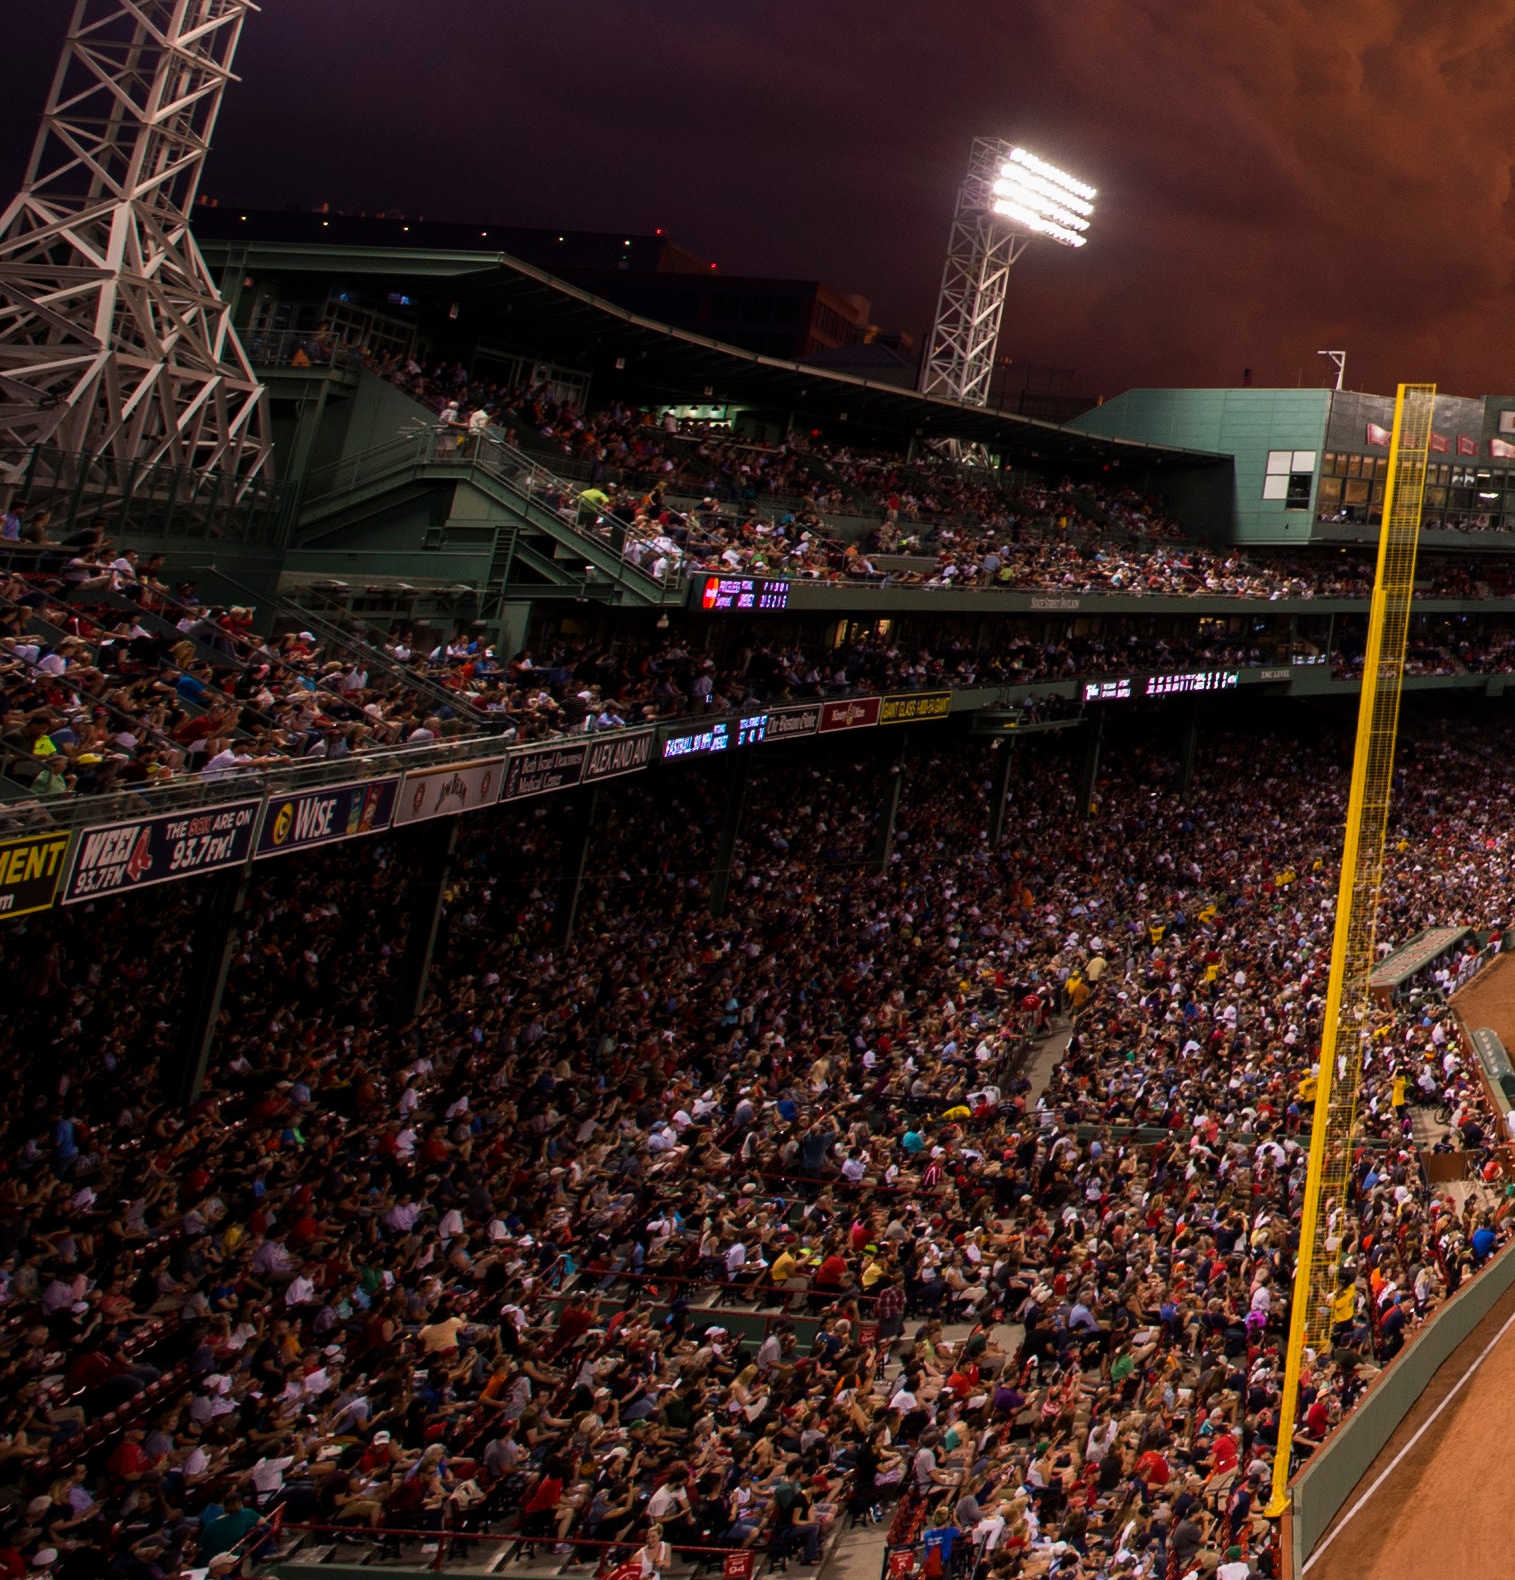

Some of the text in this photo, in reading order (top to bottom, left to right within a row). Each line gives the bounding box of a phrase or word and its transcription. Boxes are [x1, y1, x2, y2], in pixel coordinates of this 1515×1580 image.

[166, 821, 188, 841] THE
[212, 811, 234, 832] ARE
[235, 808, 251, 829] ON
[80, 826, 140, 870] WEEI
[74, 863, 126, 894] 93.7FM
